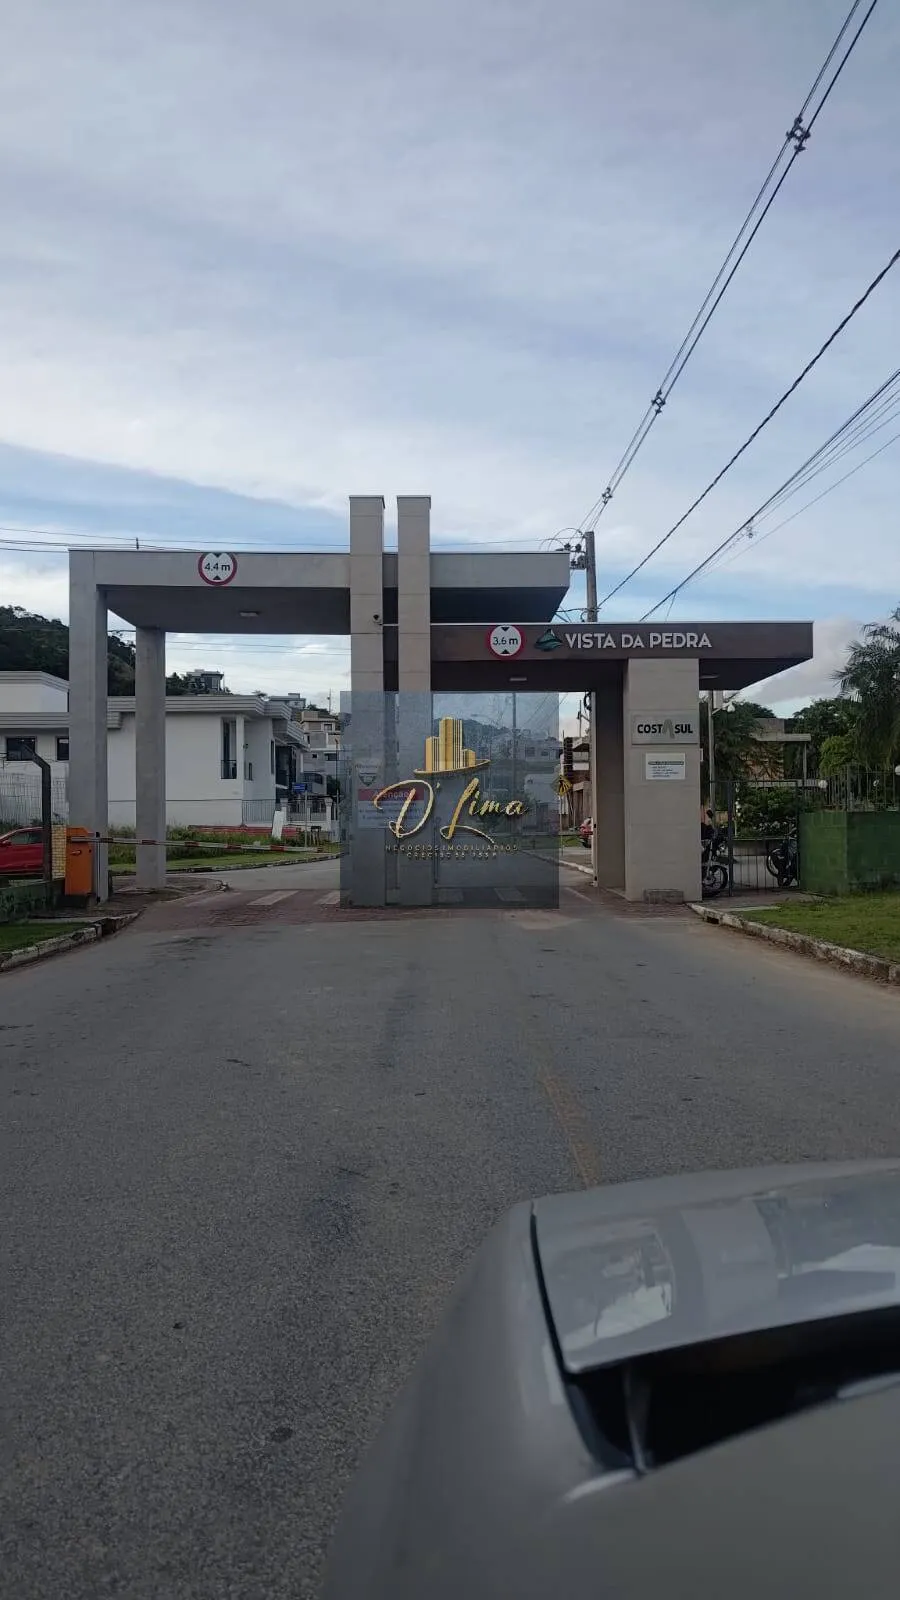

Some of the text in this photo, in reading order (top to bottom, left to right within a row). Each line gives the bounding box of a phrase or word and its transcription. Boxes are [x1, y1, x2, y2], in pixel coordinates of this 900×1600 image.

[565, 632, 713, 649] VISTA DA PEDRA
[674, 723, 693, 734] SUL
